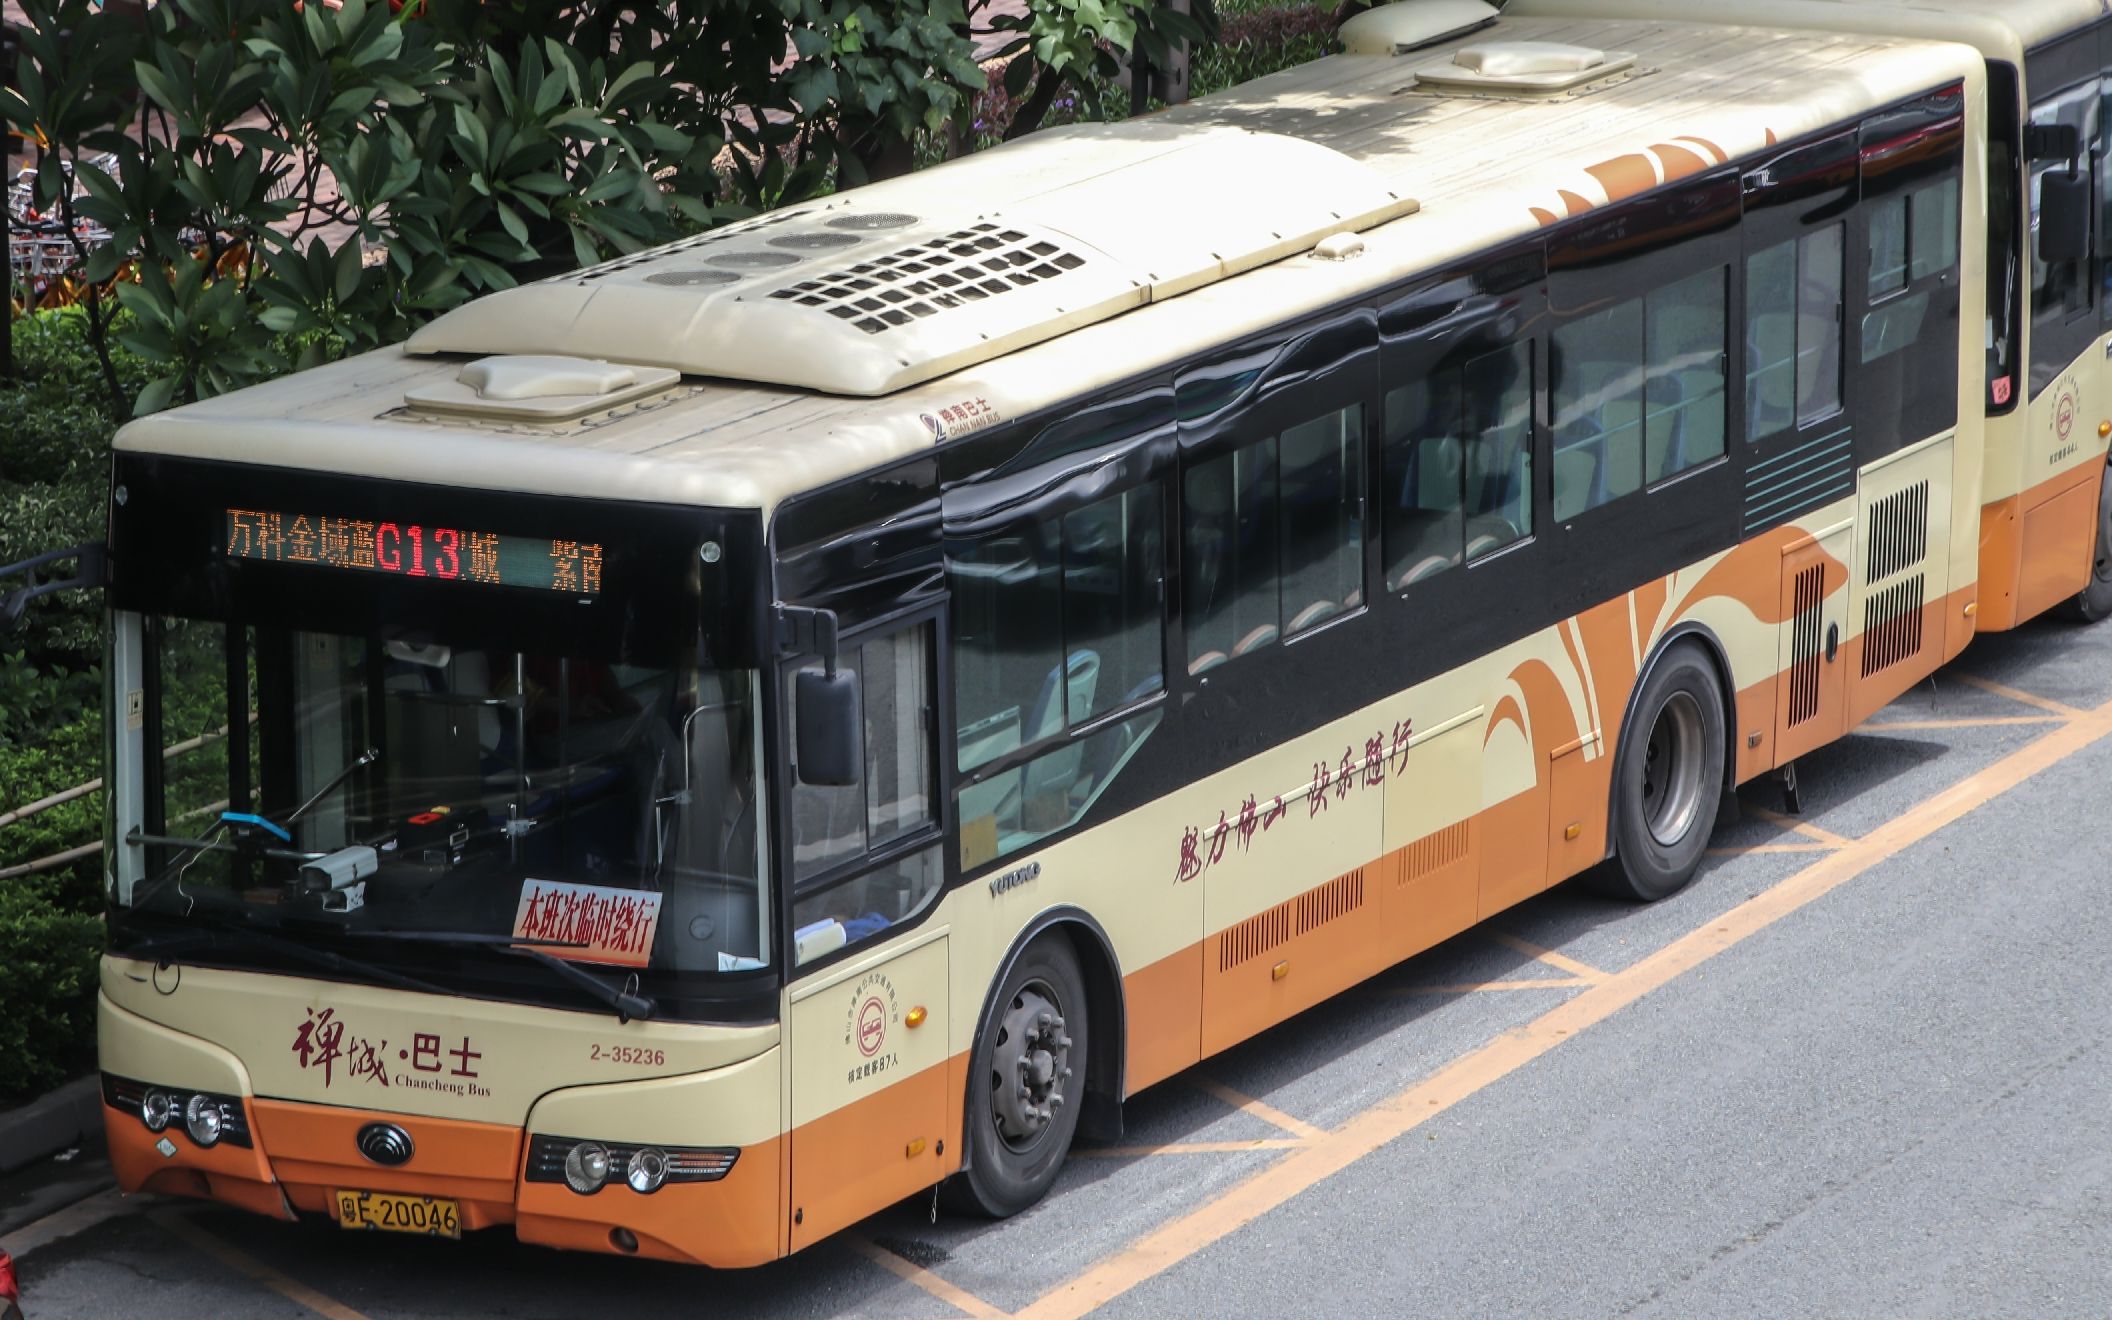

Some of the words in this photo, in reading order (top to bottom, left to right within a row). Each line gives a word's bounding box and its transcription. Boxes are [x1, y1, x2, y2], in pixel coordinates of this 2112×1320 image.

[987, 411, 1000, 425] BUS
[989, 862, 1041, 899] YUTONG
[520, 885, 655, 953] 本班次临时绕行
[590, 1044, 665, 1066] 2-35236
[395, 1073, 465, 1097] Chancheng
[468, 1082, 492, 1098] Bus
